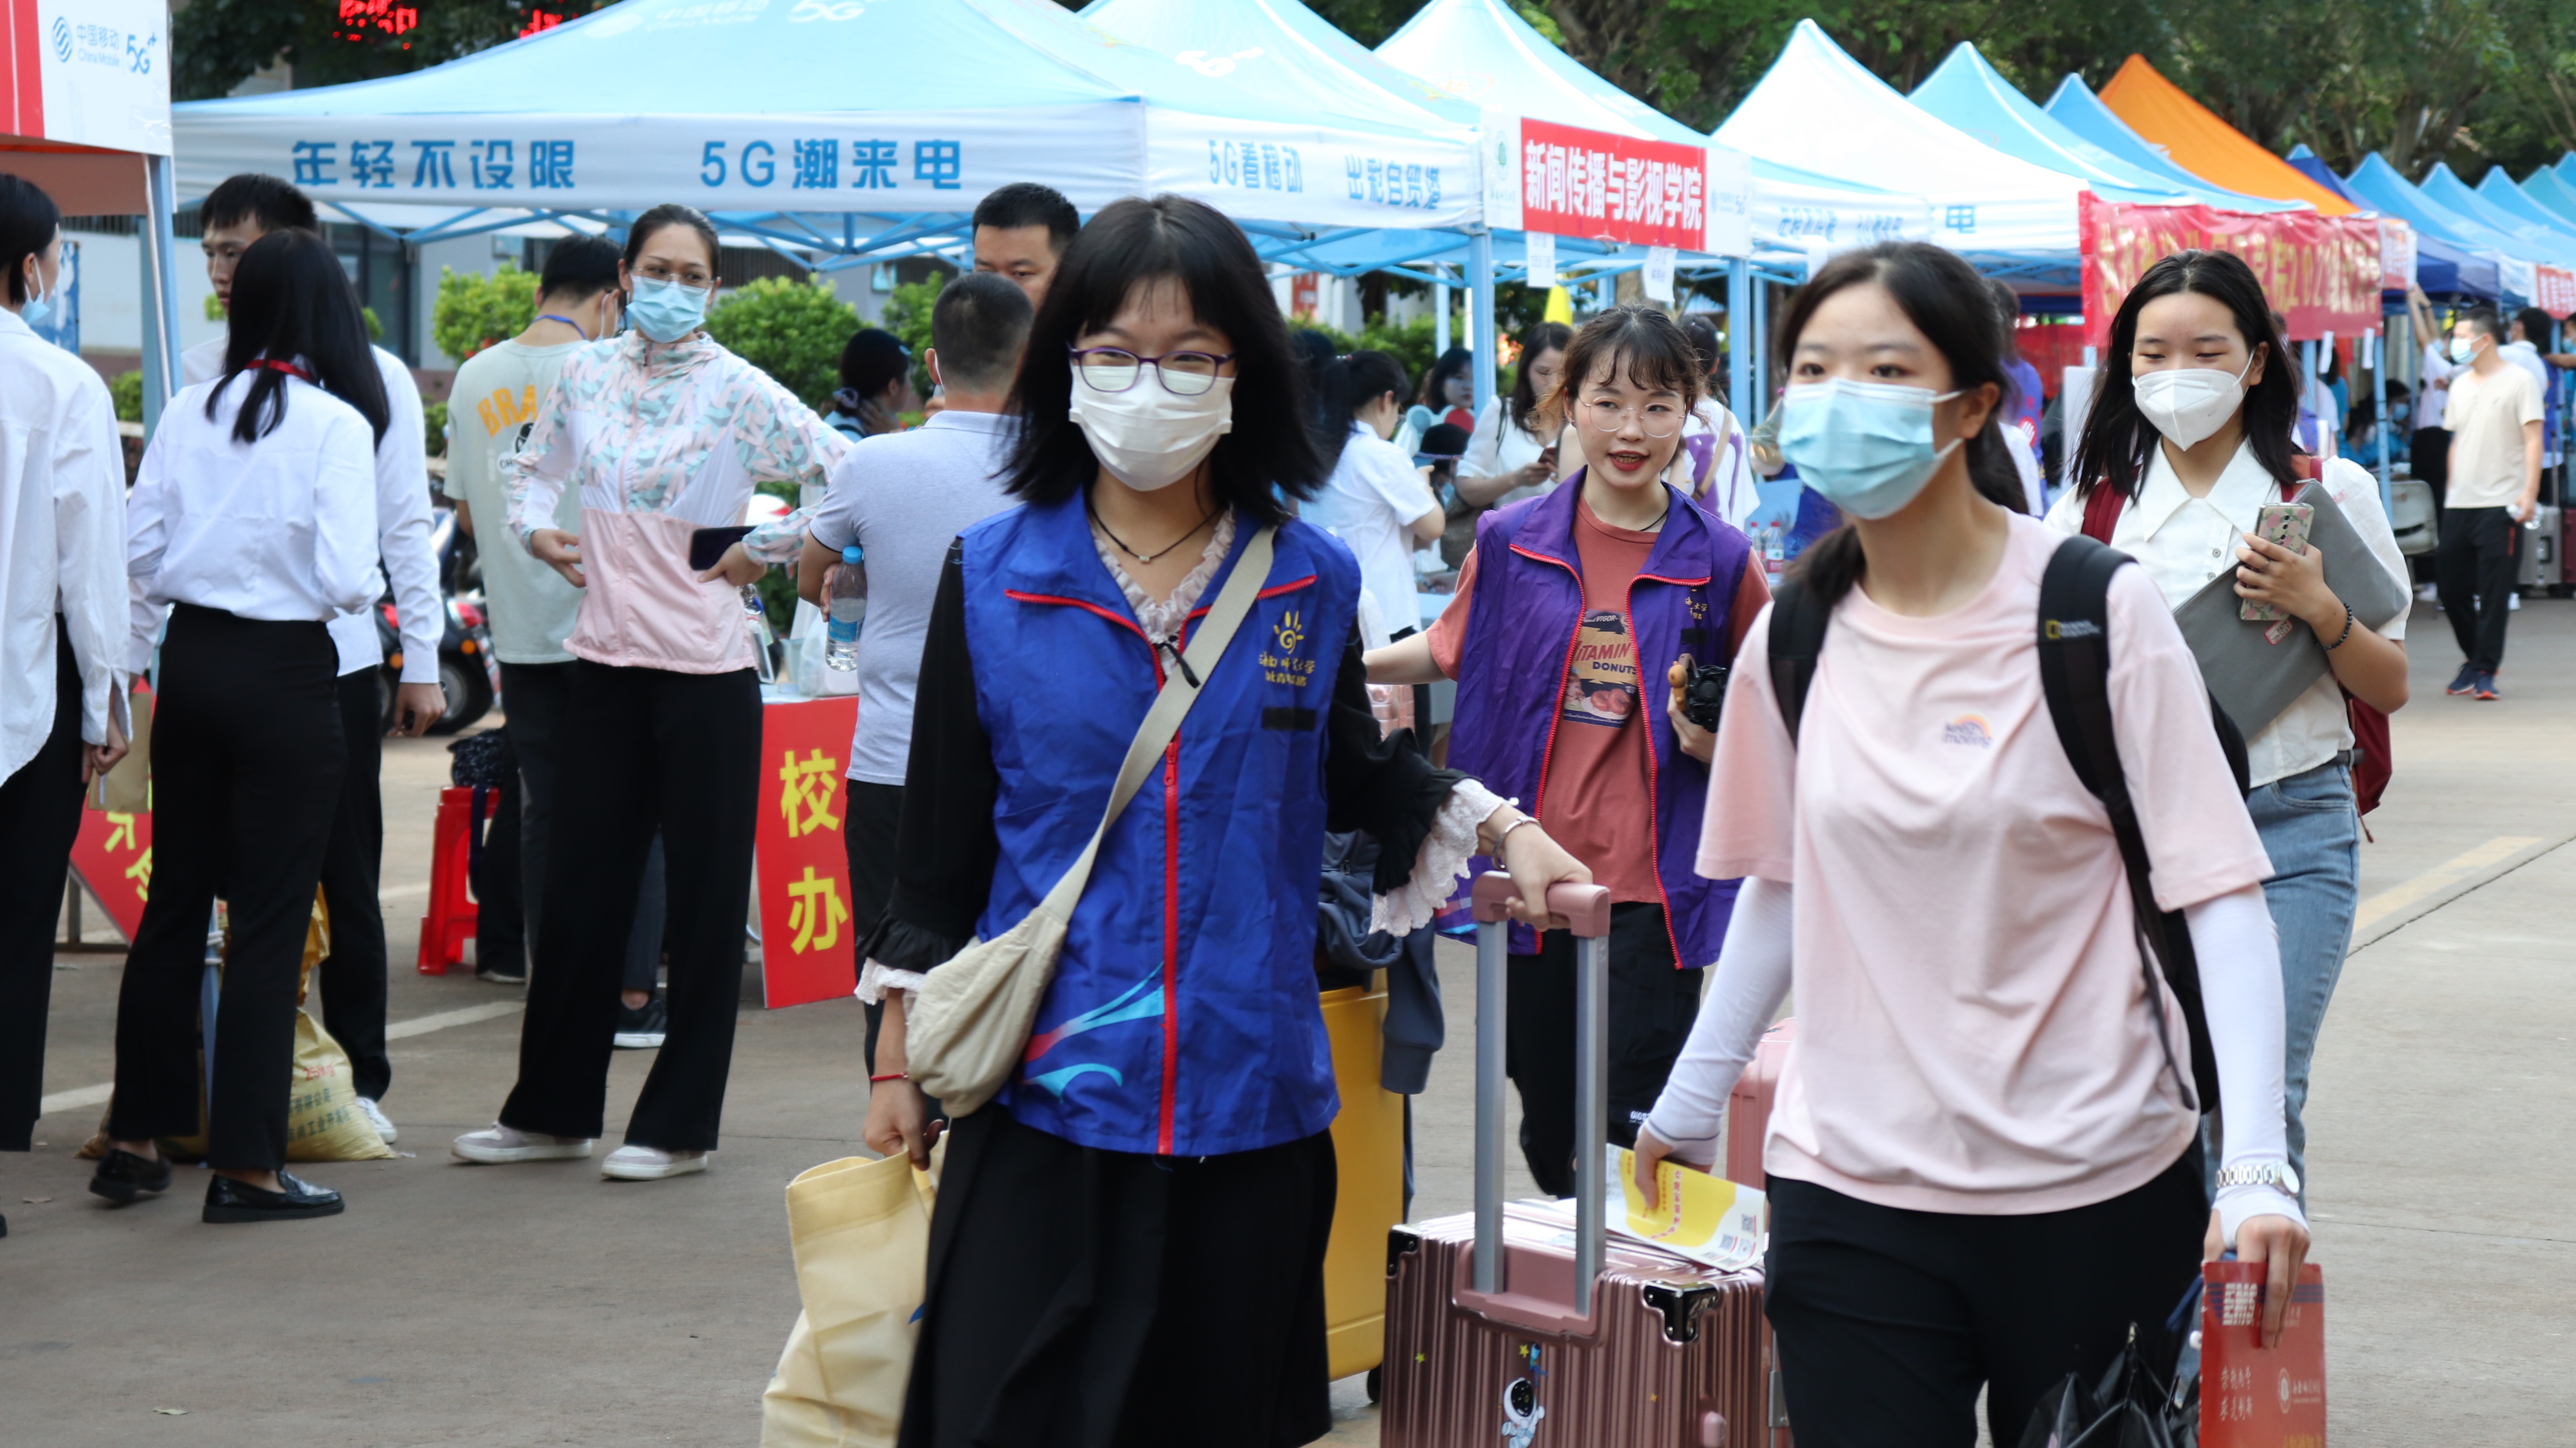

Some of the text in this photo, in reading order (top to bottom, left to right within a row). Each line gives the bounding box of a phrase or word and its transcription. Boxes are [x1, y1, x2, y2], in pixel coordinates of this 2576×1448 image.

[76, 24, 120, 50] 中国移动
[78, 48, 120, 67] China Mobile
[292, 139, 961, 190] 年轻不设限 5G潮来电
[1525, 139, 1703, 231] 新闻传播与影视学院
[477, 385, 551, 439] BRA
[779, 748, 848, 955] 校办
